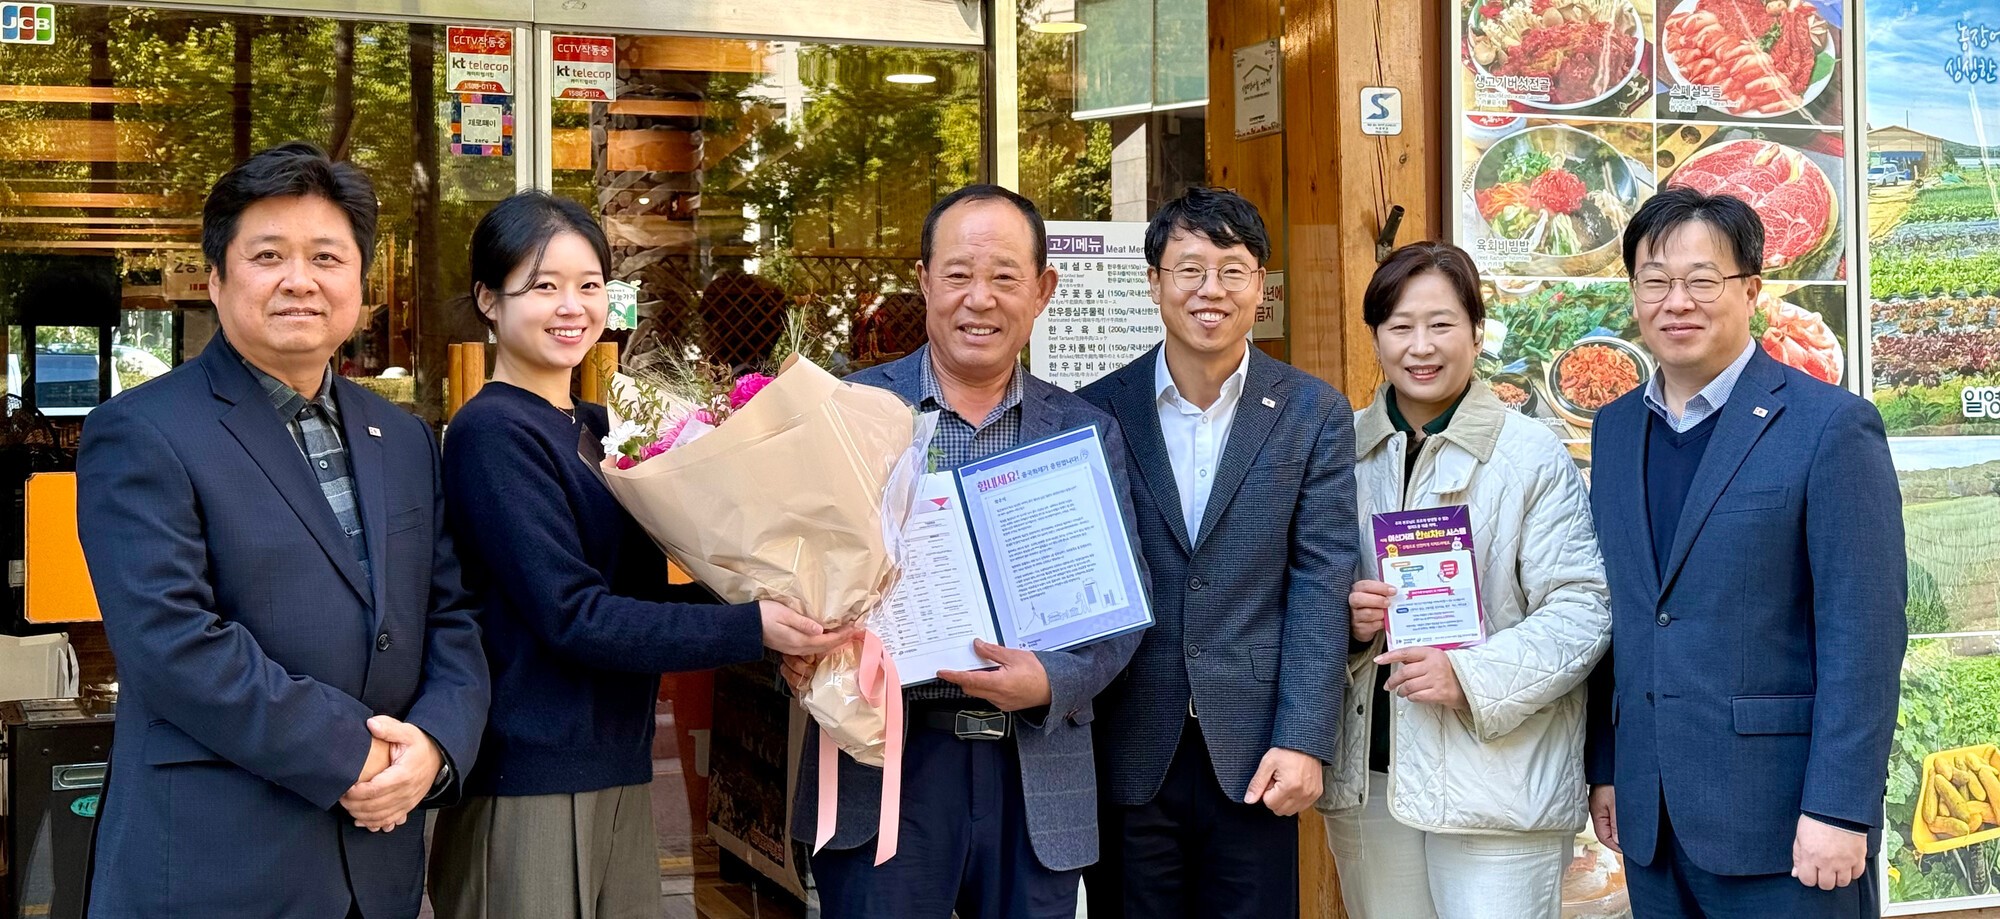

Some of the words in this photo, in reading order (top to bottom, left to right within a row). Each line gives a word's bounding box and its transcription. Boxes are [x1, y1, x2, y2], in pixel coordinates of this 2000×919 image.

[2, 16, 50, 30] JCB
[453, 35, 506, 48] CCTV작동중
[557, 43, 609, 56] CCTV작동중
[452, 57, 466, 69] kt
[468, 60, 509, 73] telecop
[1945, 57, 1997, 82] 싱싱한
[556, 64, 570, 77] kt
[572, 68, 612, 81] telecop
[1475, 75, 1550, 91] 생고기버섯전골
[1670, 84, 1722, 98] 스페셜모듬
[1049, 237, 1102, 253] 고기메뉴
[1106, 245, 1126, 253] Meat
[1476, 238, 1530, 253] 육회비빔밥
[1048, 307, 1105, 317] 한우등심주물럭
[1255, 305, 1274, 322] 금지
[1108, 325, 1162, 334] (200g/국내산한우)
[1048, 343, 1106, 353] 한우차돌박이
[977, 470, 1020, 492] 힘내세요!
[1446, 527, 1466, 537] 시스템
